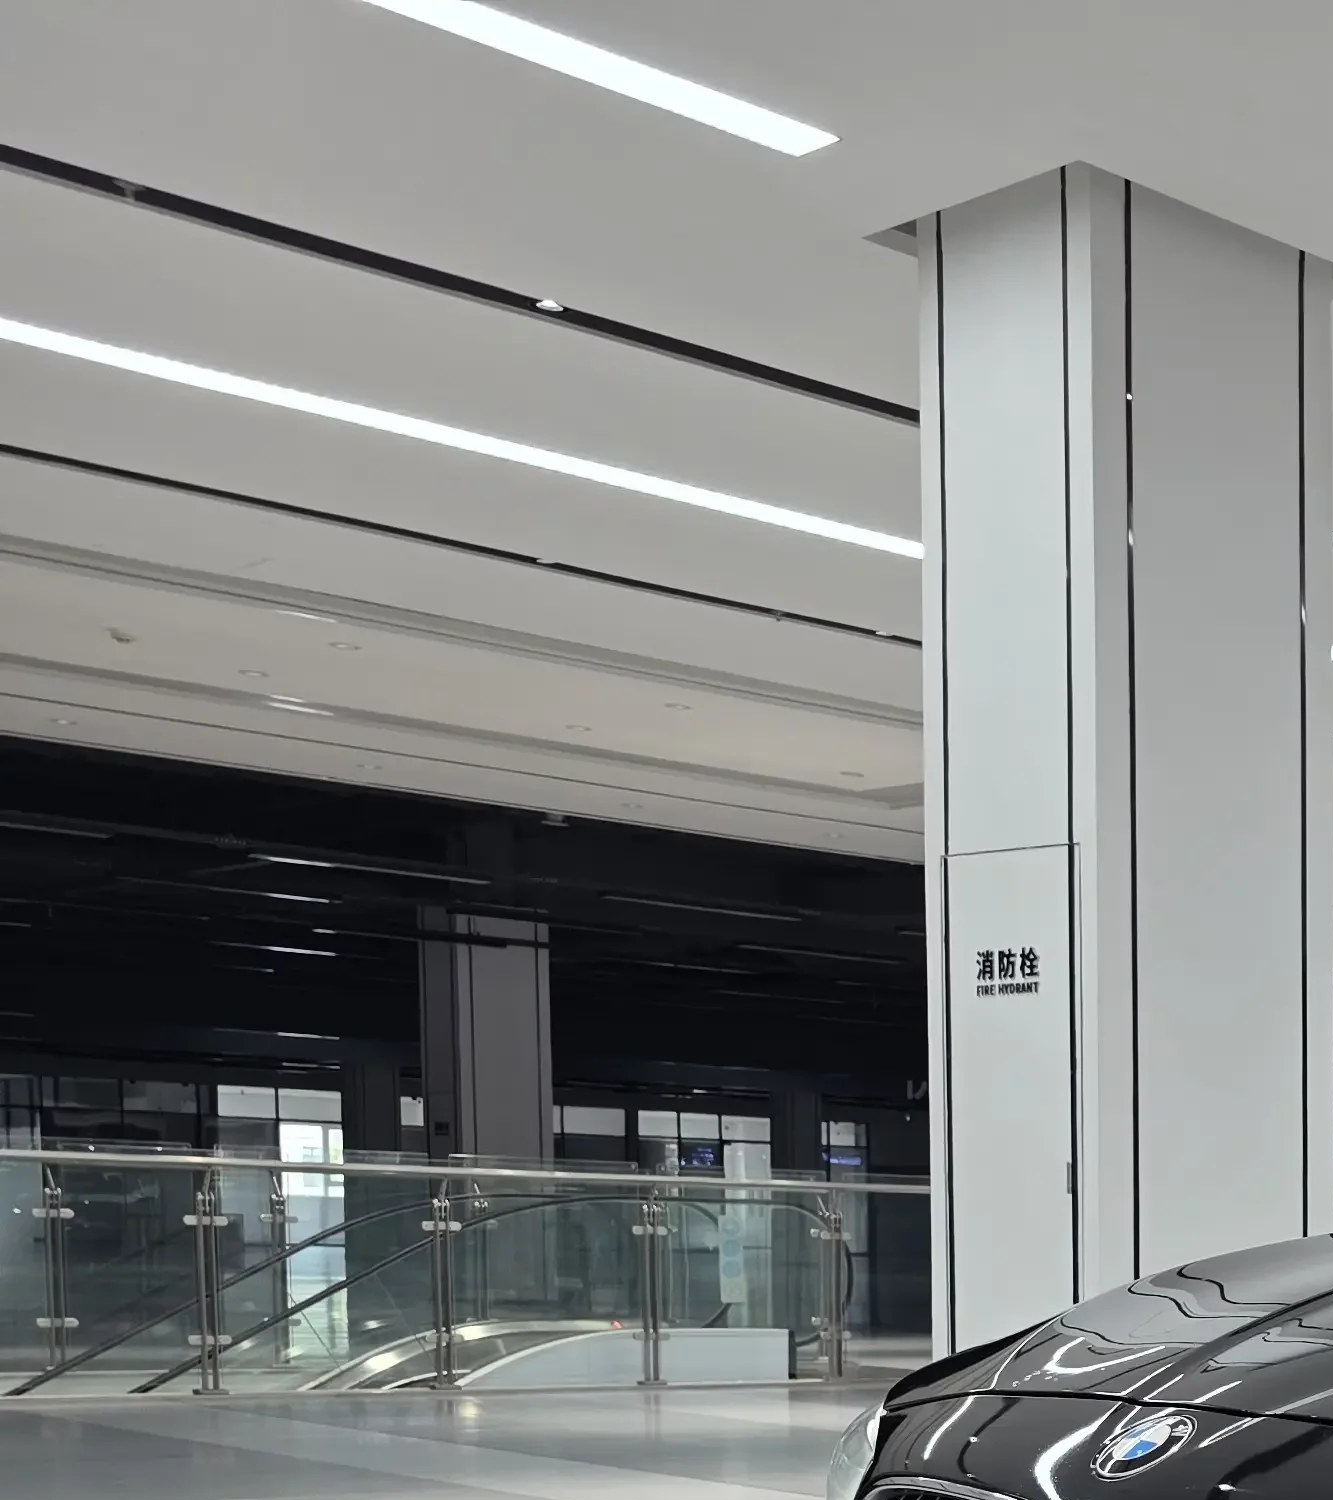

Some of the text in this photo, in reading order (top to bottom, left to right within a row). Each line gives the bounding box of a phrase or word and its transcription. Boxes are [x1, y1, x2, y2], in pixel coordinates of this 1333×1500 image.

[976, 946, 1040, 982] 消防栓
[976, 981, 1039, 998] FIRE HYDRANT
